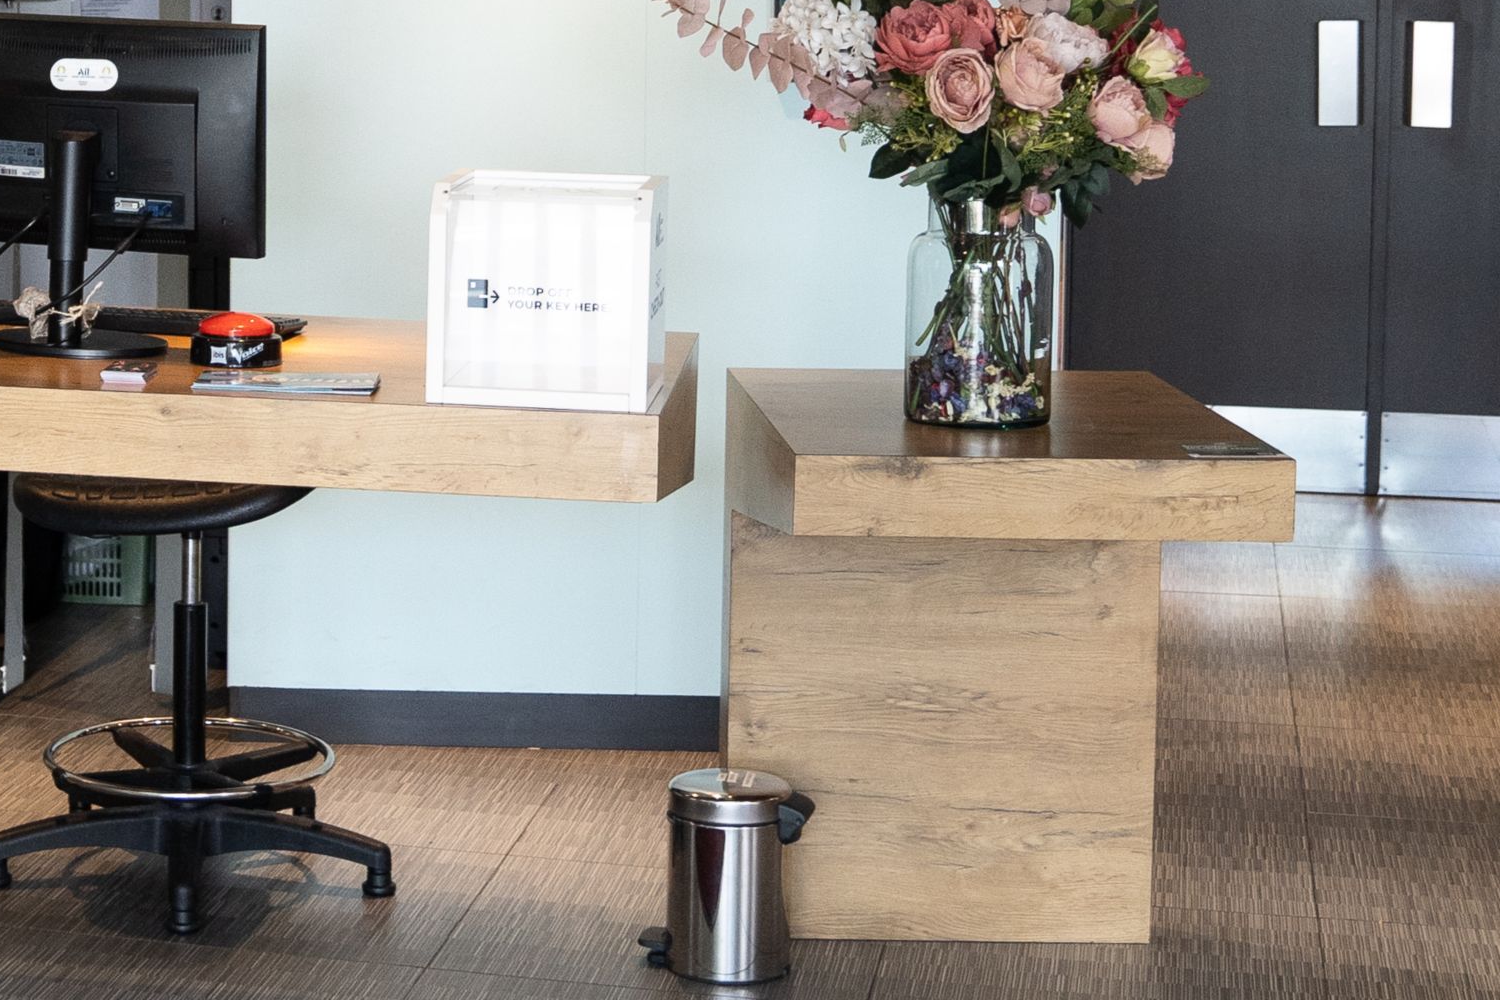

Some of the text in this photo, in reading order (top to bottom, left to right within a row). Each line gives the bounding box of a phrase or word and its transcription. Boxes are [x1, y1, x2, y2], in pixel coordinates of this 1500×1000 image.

[508, 287, 544, 296] DROP
[508, 300, 609, 312] YOUR KEY HERE
